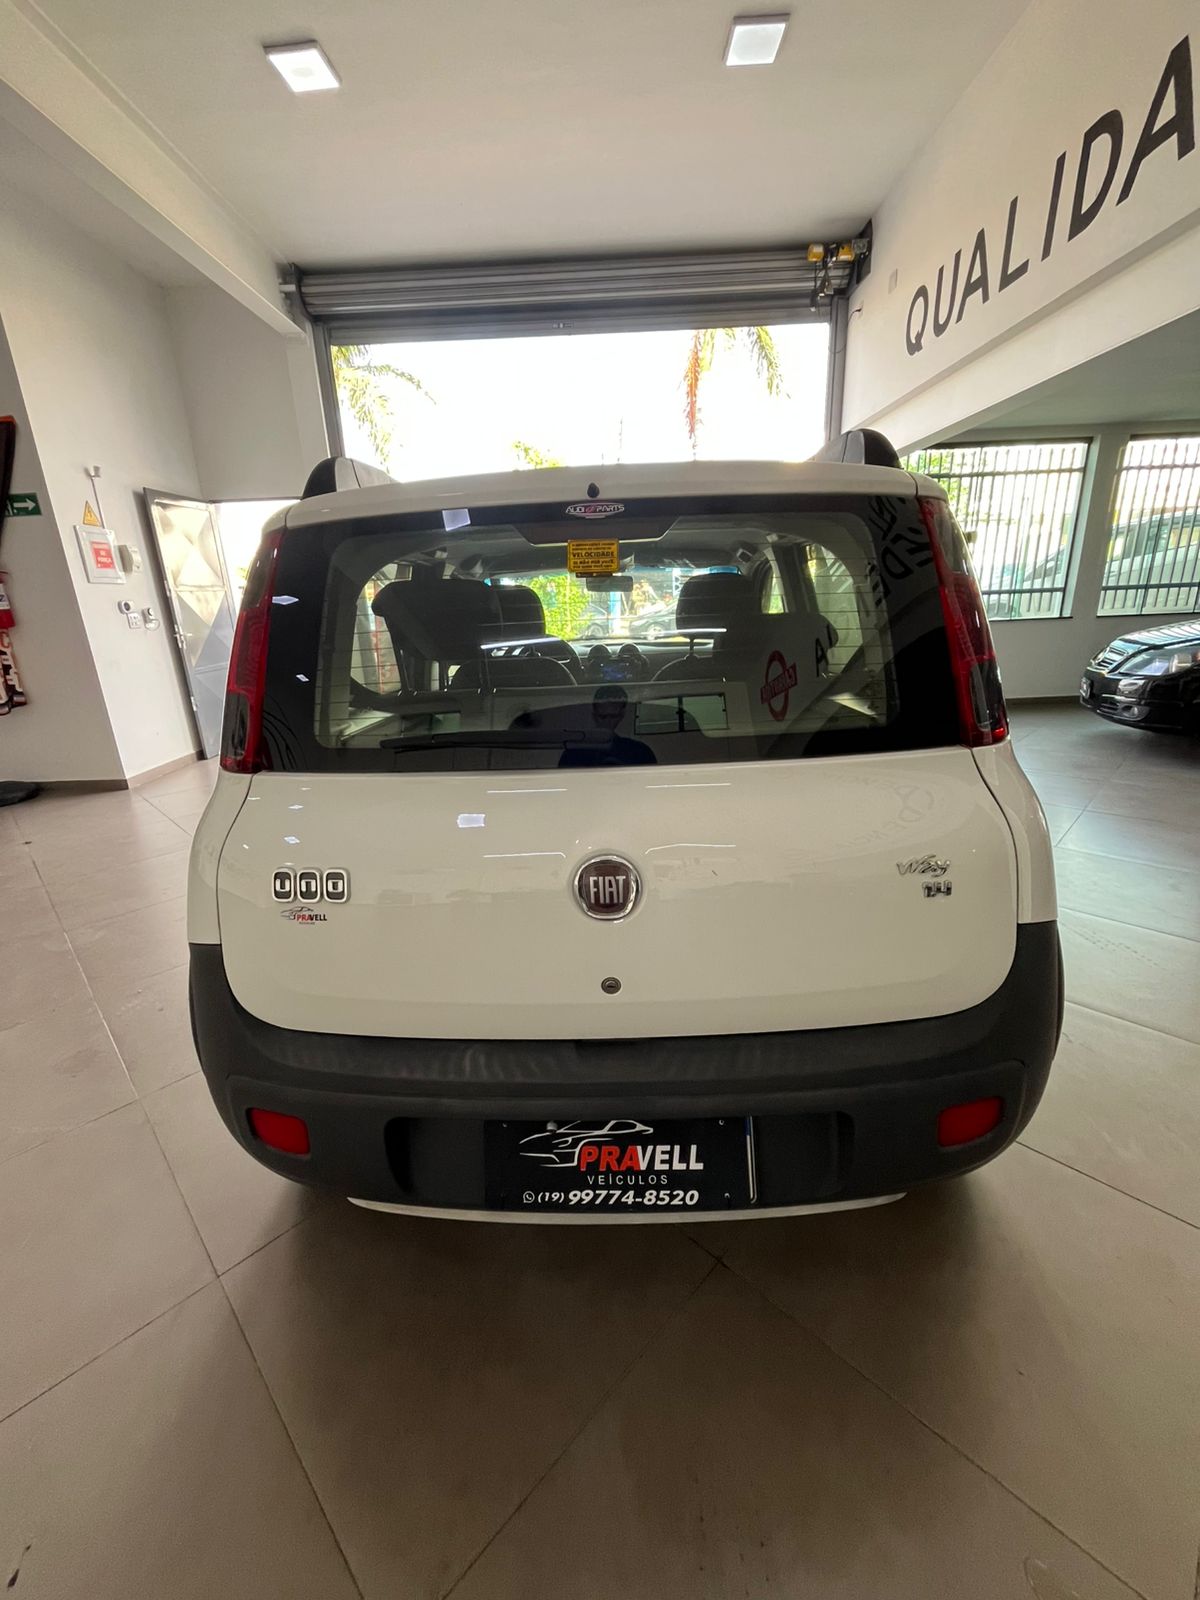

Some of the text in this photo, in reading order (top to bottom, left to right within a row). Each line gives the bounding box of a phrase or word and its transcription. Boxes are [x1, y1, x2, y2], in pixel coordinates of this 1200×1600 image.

[905, 34, 1197, 357] QUALIDA
[589, 875, 626, 904] FIAT
[296, 913, 327, 921] PRAVELL
[579, 1144, 704, 1172] PRAVELL
[587, 1174, 668, 1186] VEÍCULOS
[537, 1189, 700, 1206] (19) 99774-8520
